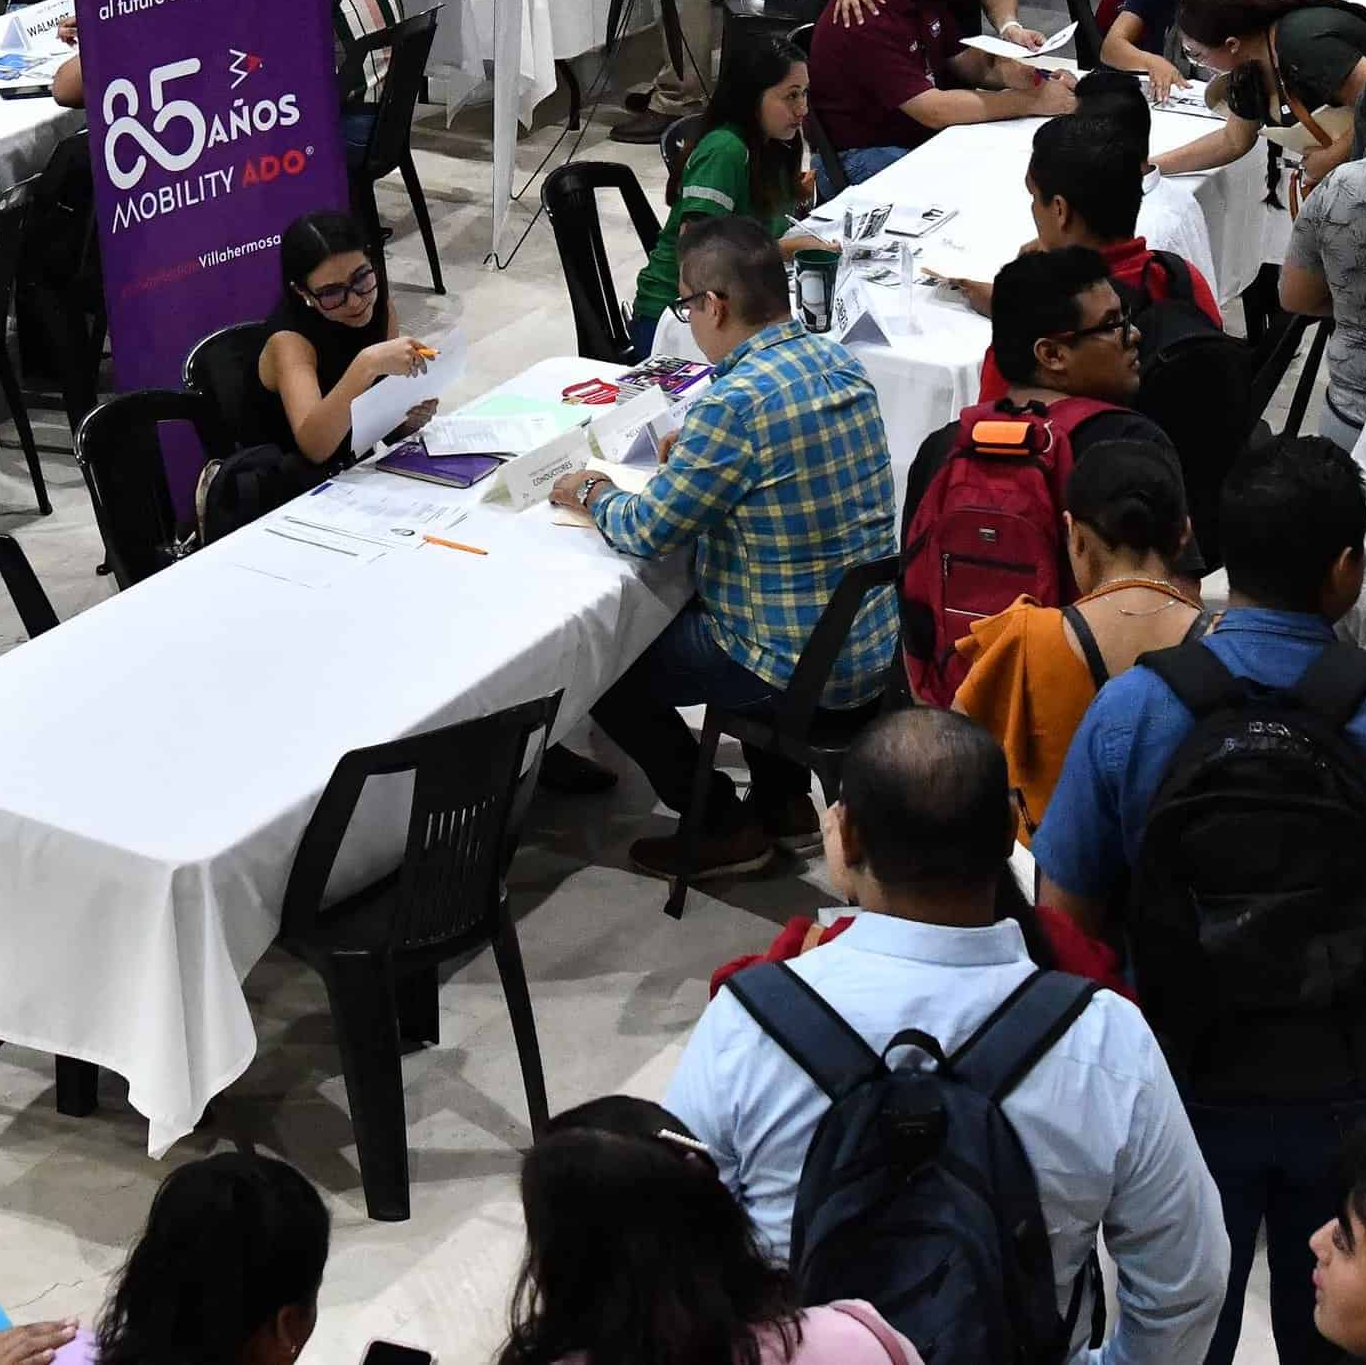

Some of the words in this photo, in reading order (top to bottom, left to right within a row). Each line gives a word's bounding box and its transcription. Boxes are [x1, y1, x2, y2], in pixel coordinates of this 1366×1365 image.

[99, 0, 114, 20] al
[103, 57, 206, 190] 85
[207, 93, 301, 148] AÑOS
[112, 166, 235, 234] MOBILITY
